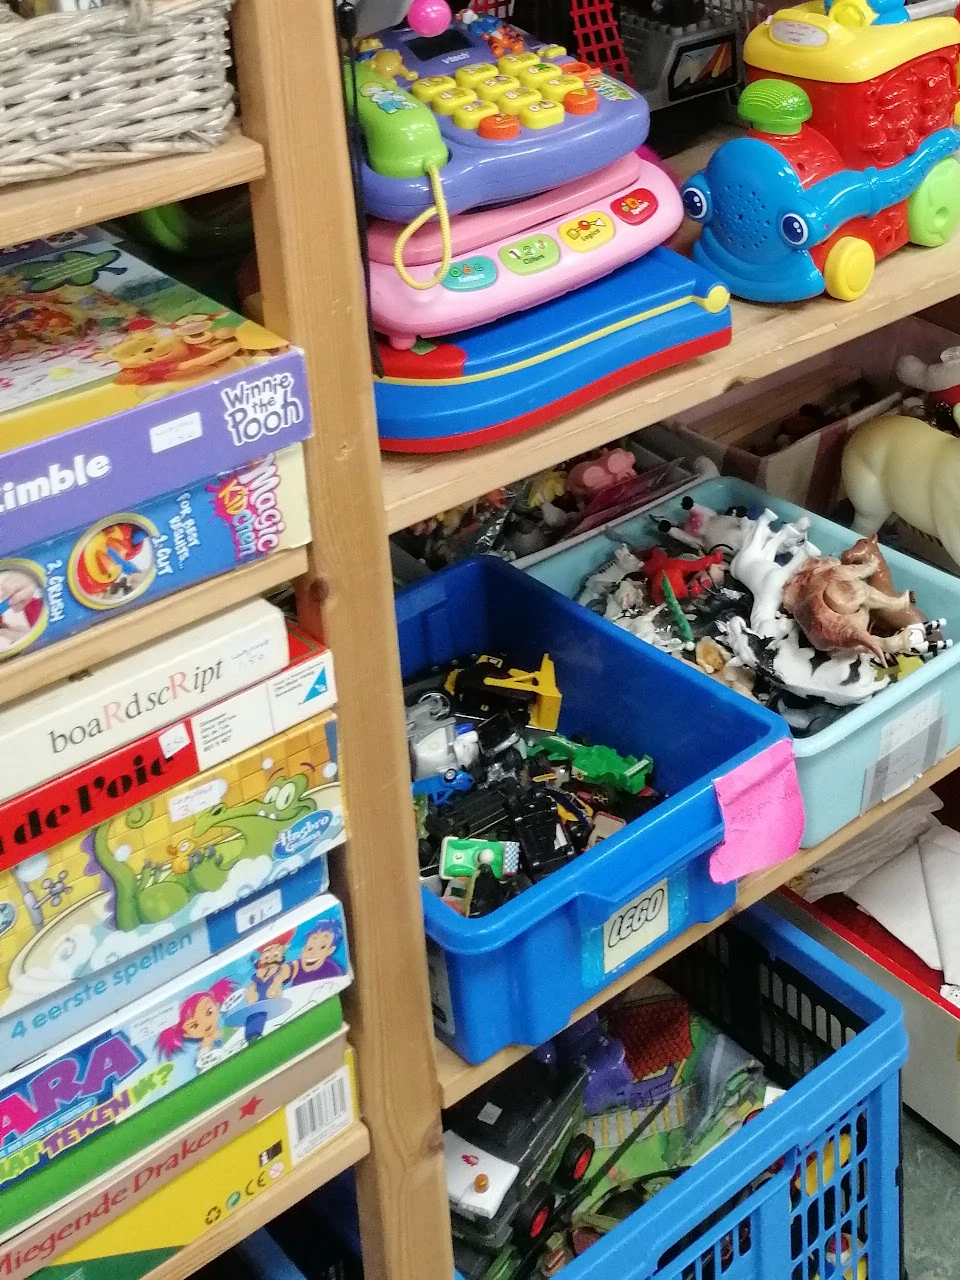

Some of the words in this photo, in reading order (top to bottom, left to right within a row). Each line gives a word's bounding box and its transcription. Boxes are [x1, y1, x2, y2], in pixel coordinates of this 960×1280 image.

[224, 373, 292, 409] Winnie
[251, 395, 277, 415] the
[228, 390, 301, 445] Pooh
[237, 452, 287, 553] Magic
[181, 517, 202, 548] BEST
[156, 547, 174, 576] CUT
[47, 575, 66, 623] CRUSH
[12, 803, 71, 846] de
[277, 814, 330, 846] Hasbro
[606, 886, 666, 949] LEGO
[10, 1019, 28, 1040] 4
[31, 984, 108, 1028] eerste
[112, 933, 193, 986] spellen
[42, 1088, 132, 1157] TEKEN
[132, 1120, 230, 1194] Draken
